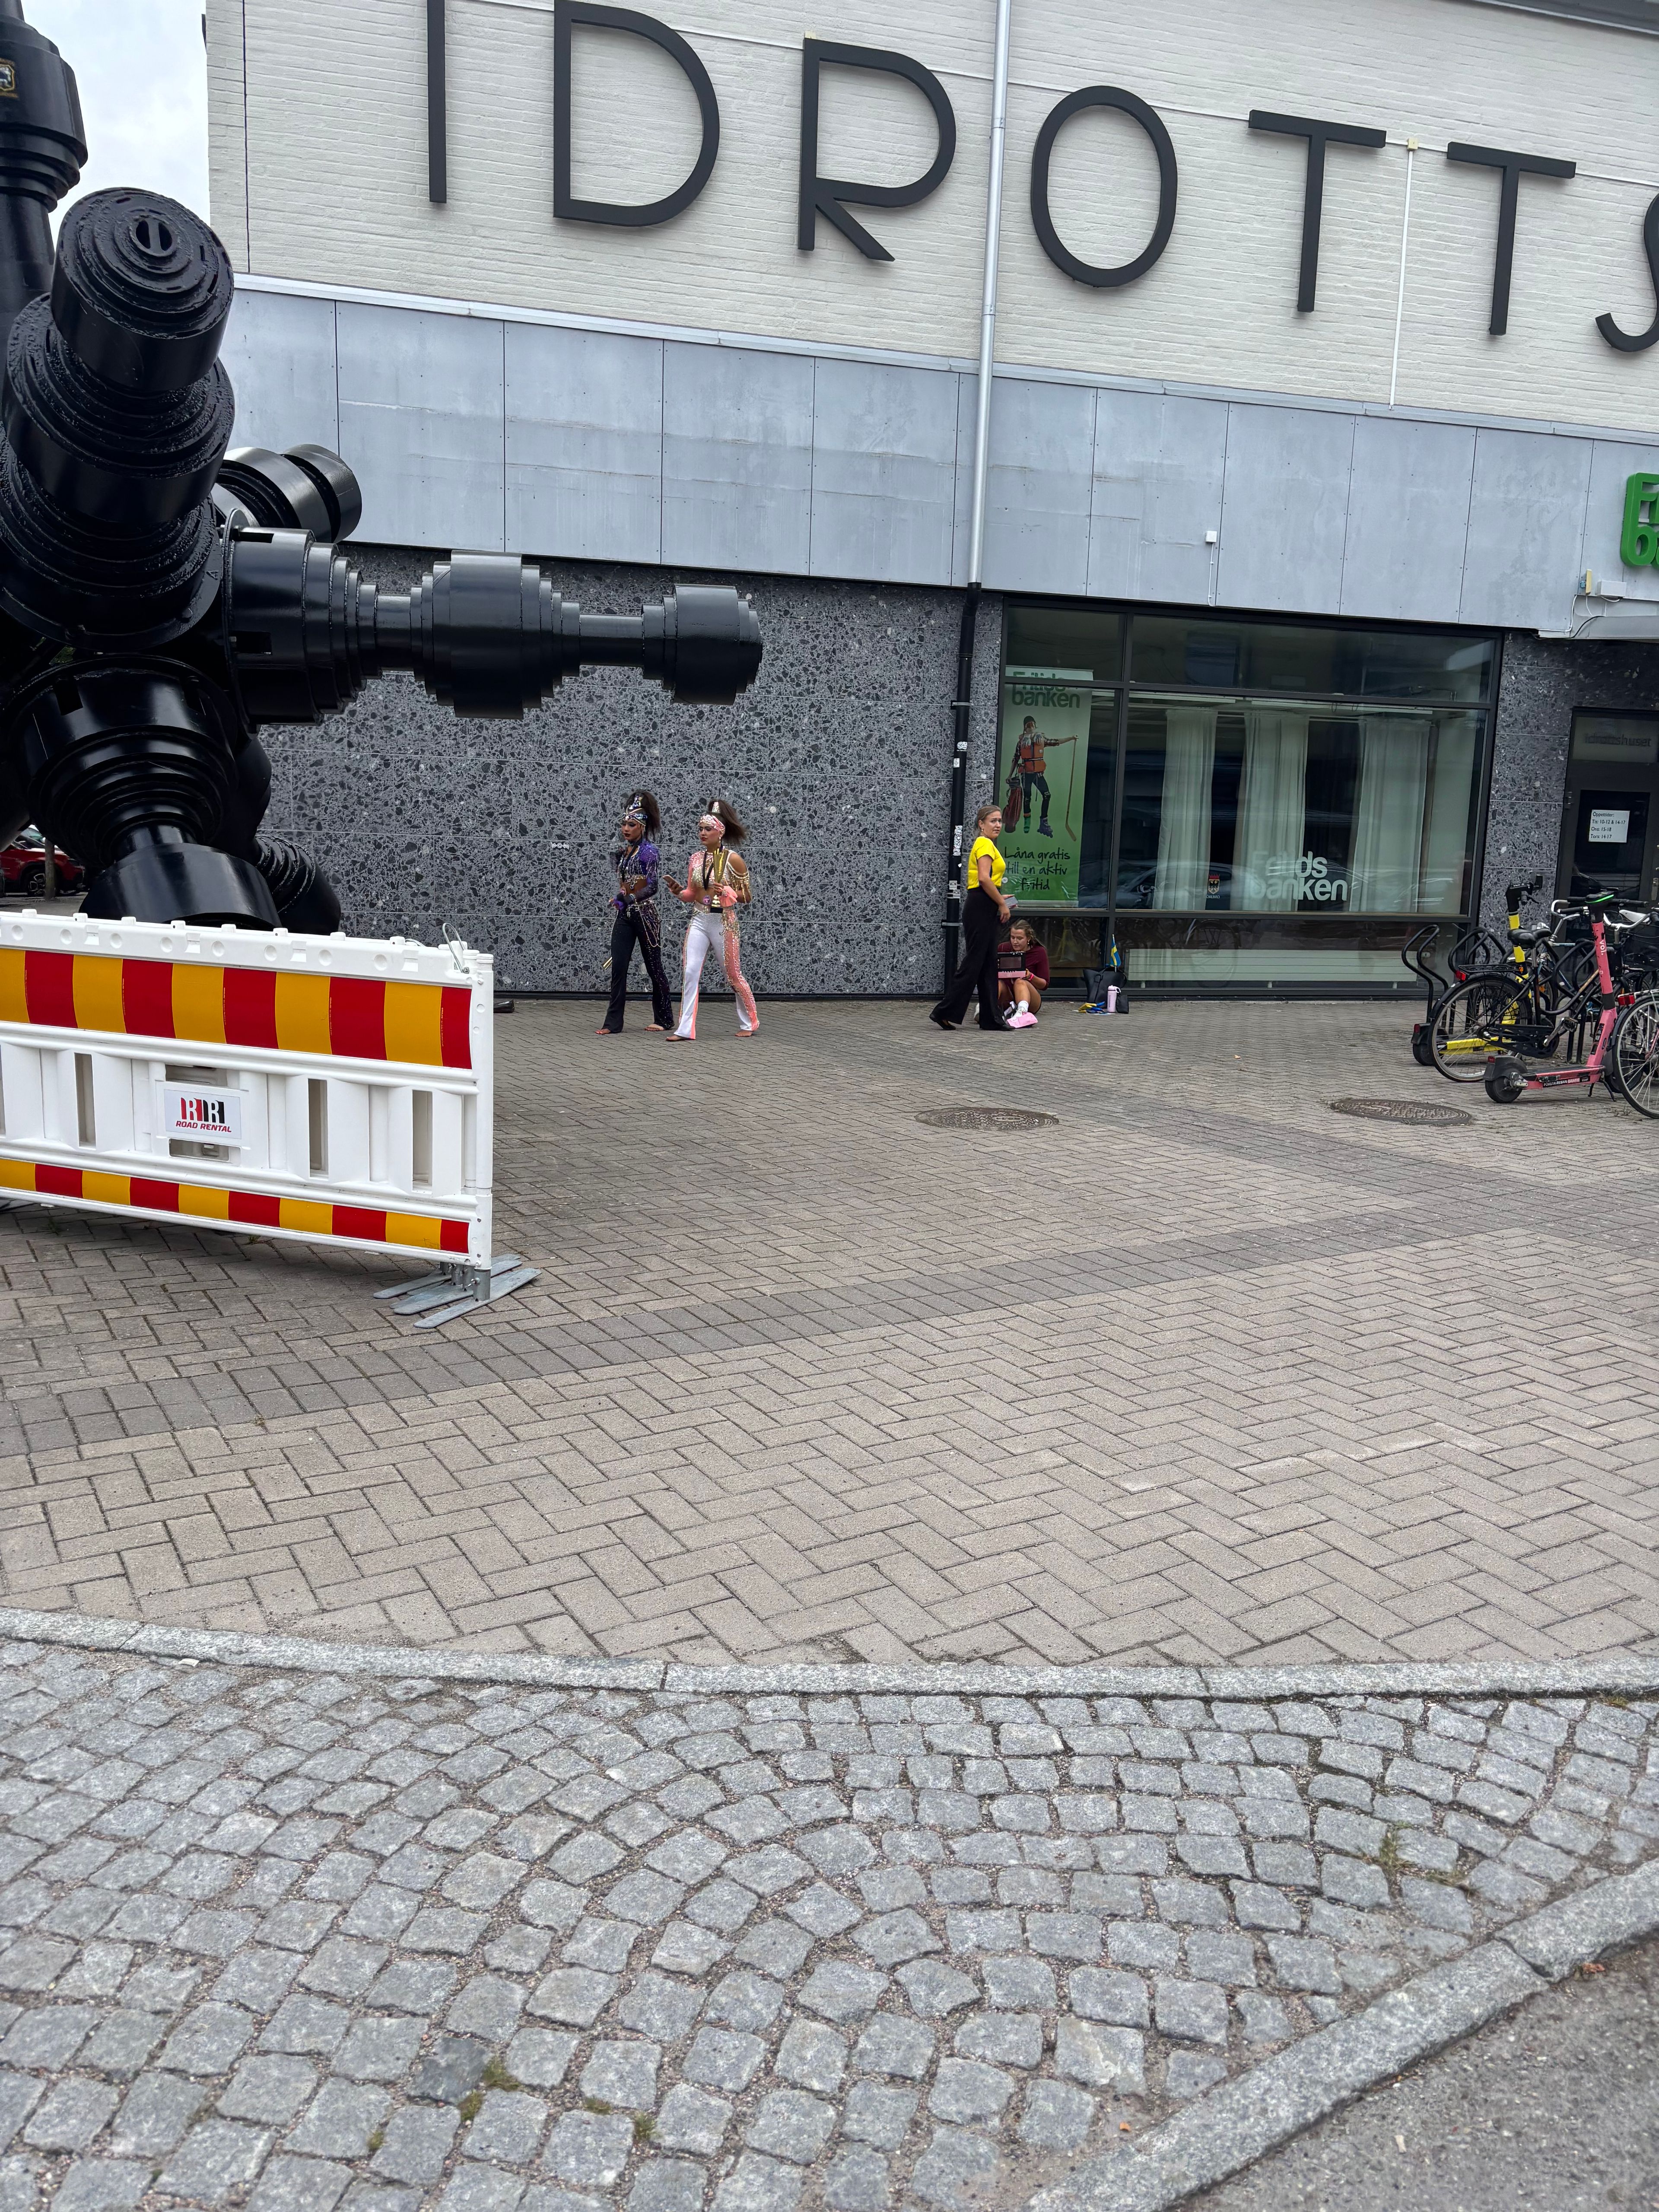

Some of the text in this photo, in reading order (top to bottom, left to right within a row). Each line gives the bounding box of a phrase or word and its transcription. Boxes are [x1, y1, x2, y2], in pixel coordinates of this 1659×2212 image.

[1012, 690, 1080, 709] banken
[1004, 846, 1071, 864] Låna gratis
[1005, 861, 1067, 875] till en aktiv
[1249, 877, 1348, 901] banken
[200, 1123, 232, 1132] RENTAL
